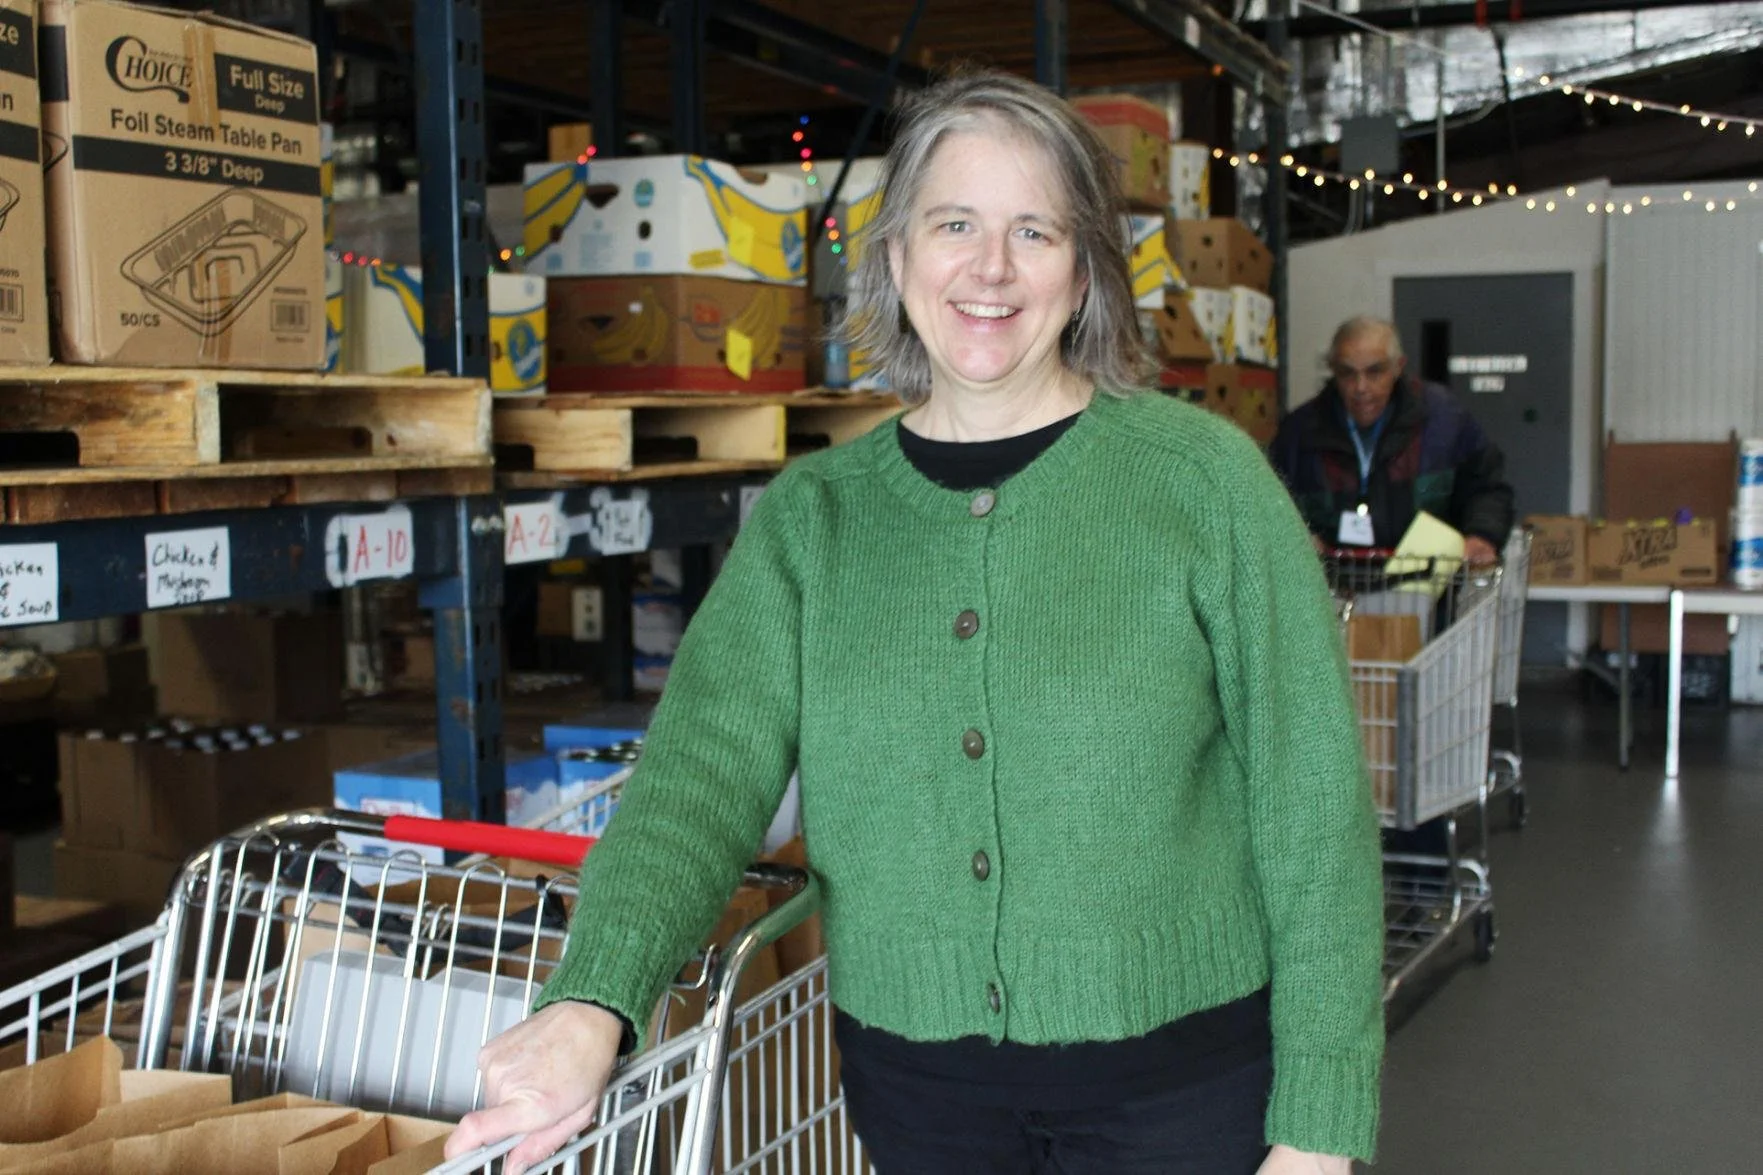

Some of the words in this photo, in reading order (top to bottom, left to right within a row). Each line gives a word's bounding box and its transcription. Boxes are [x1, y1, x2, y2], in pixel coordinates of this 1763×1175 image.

[105, 35, 194, 104] CHOICE
[230, 64, 264, 92] Full
[268, 72, 304, 99] Size
[255, 94, 285, 114] Deep
[110, 108, 149, 133] Foil
[155, 114, 215, 142] Steam
[219, 123, 266, 149] Table
[271, 131, 302, 155] Pan
[165, 151, 177, 172] 3
[222, 160, 264, 185] Deep
[353, 525, 408, 574] A-10
